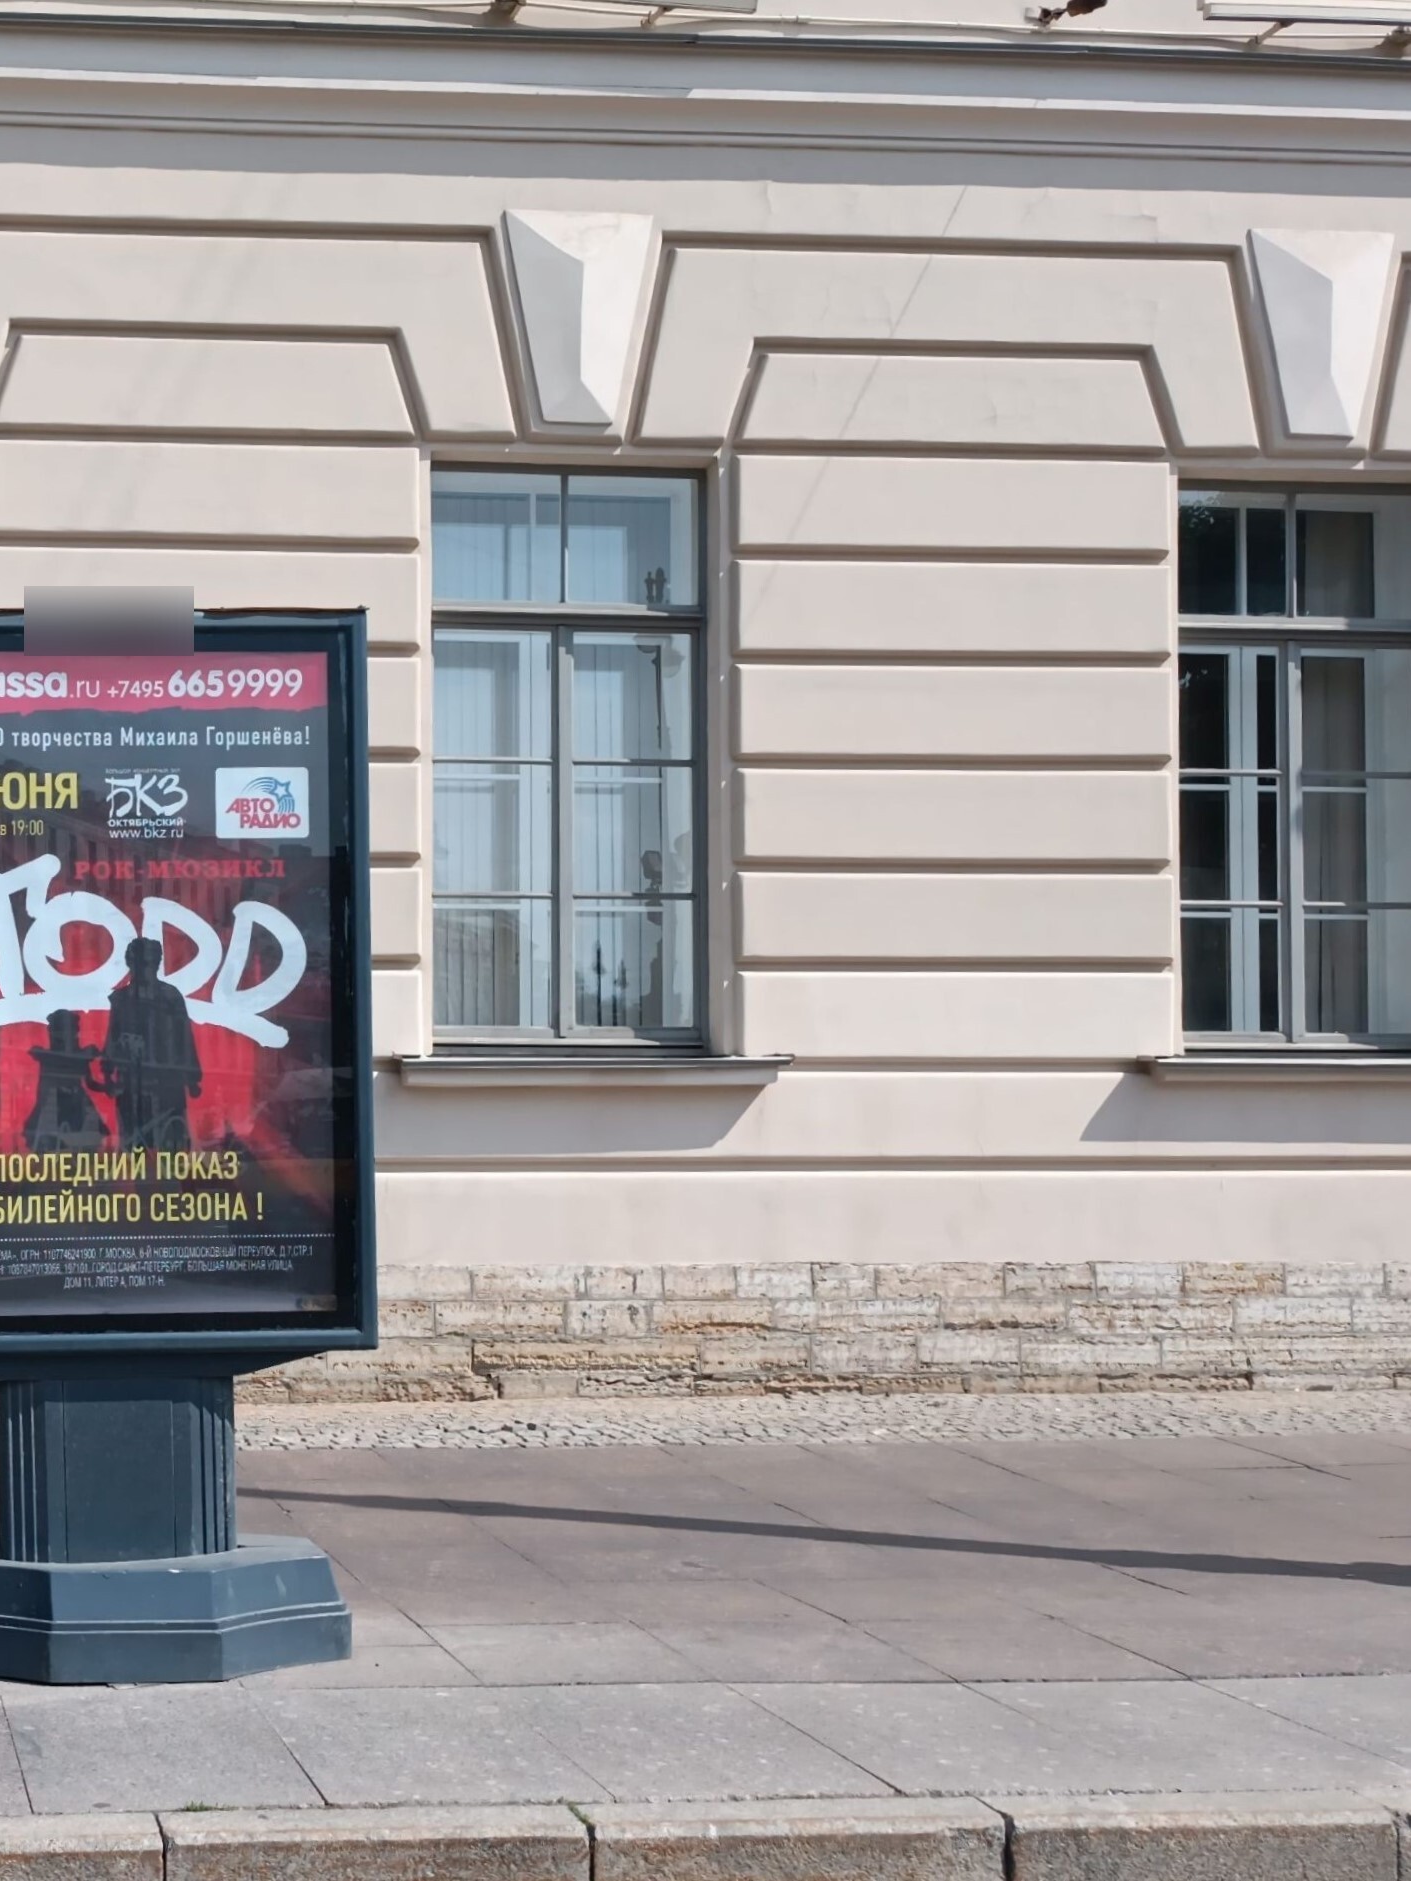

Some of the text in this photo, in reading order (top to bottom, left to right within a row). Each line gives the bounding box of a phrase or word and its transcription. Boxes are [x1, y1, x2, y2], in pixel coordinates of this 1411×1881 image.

[107, 681, 164, 698] +7495
[12, 731, 112, 751] творчества
[120, 727, 198, 746] Михаила
[206, 726, 310, 750] Горшенёва!
[105, 774, 188, 818] БКЗ
[225, 798, 275, 814] АВТО
[0, 824, 7, 836] в
[11, 819, 44, 836] 19:00
[240, 813, 301, 829] РАДИО
[109, 827, 184, 839] www.bkz.ru
[74, 859, 286, 880] РОК-МЮЗИКЛ
[156, 1151, 239, 1180] ПОКАЗ
[150, 1193, 248, 1222] СЕЗОНА
